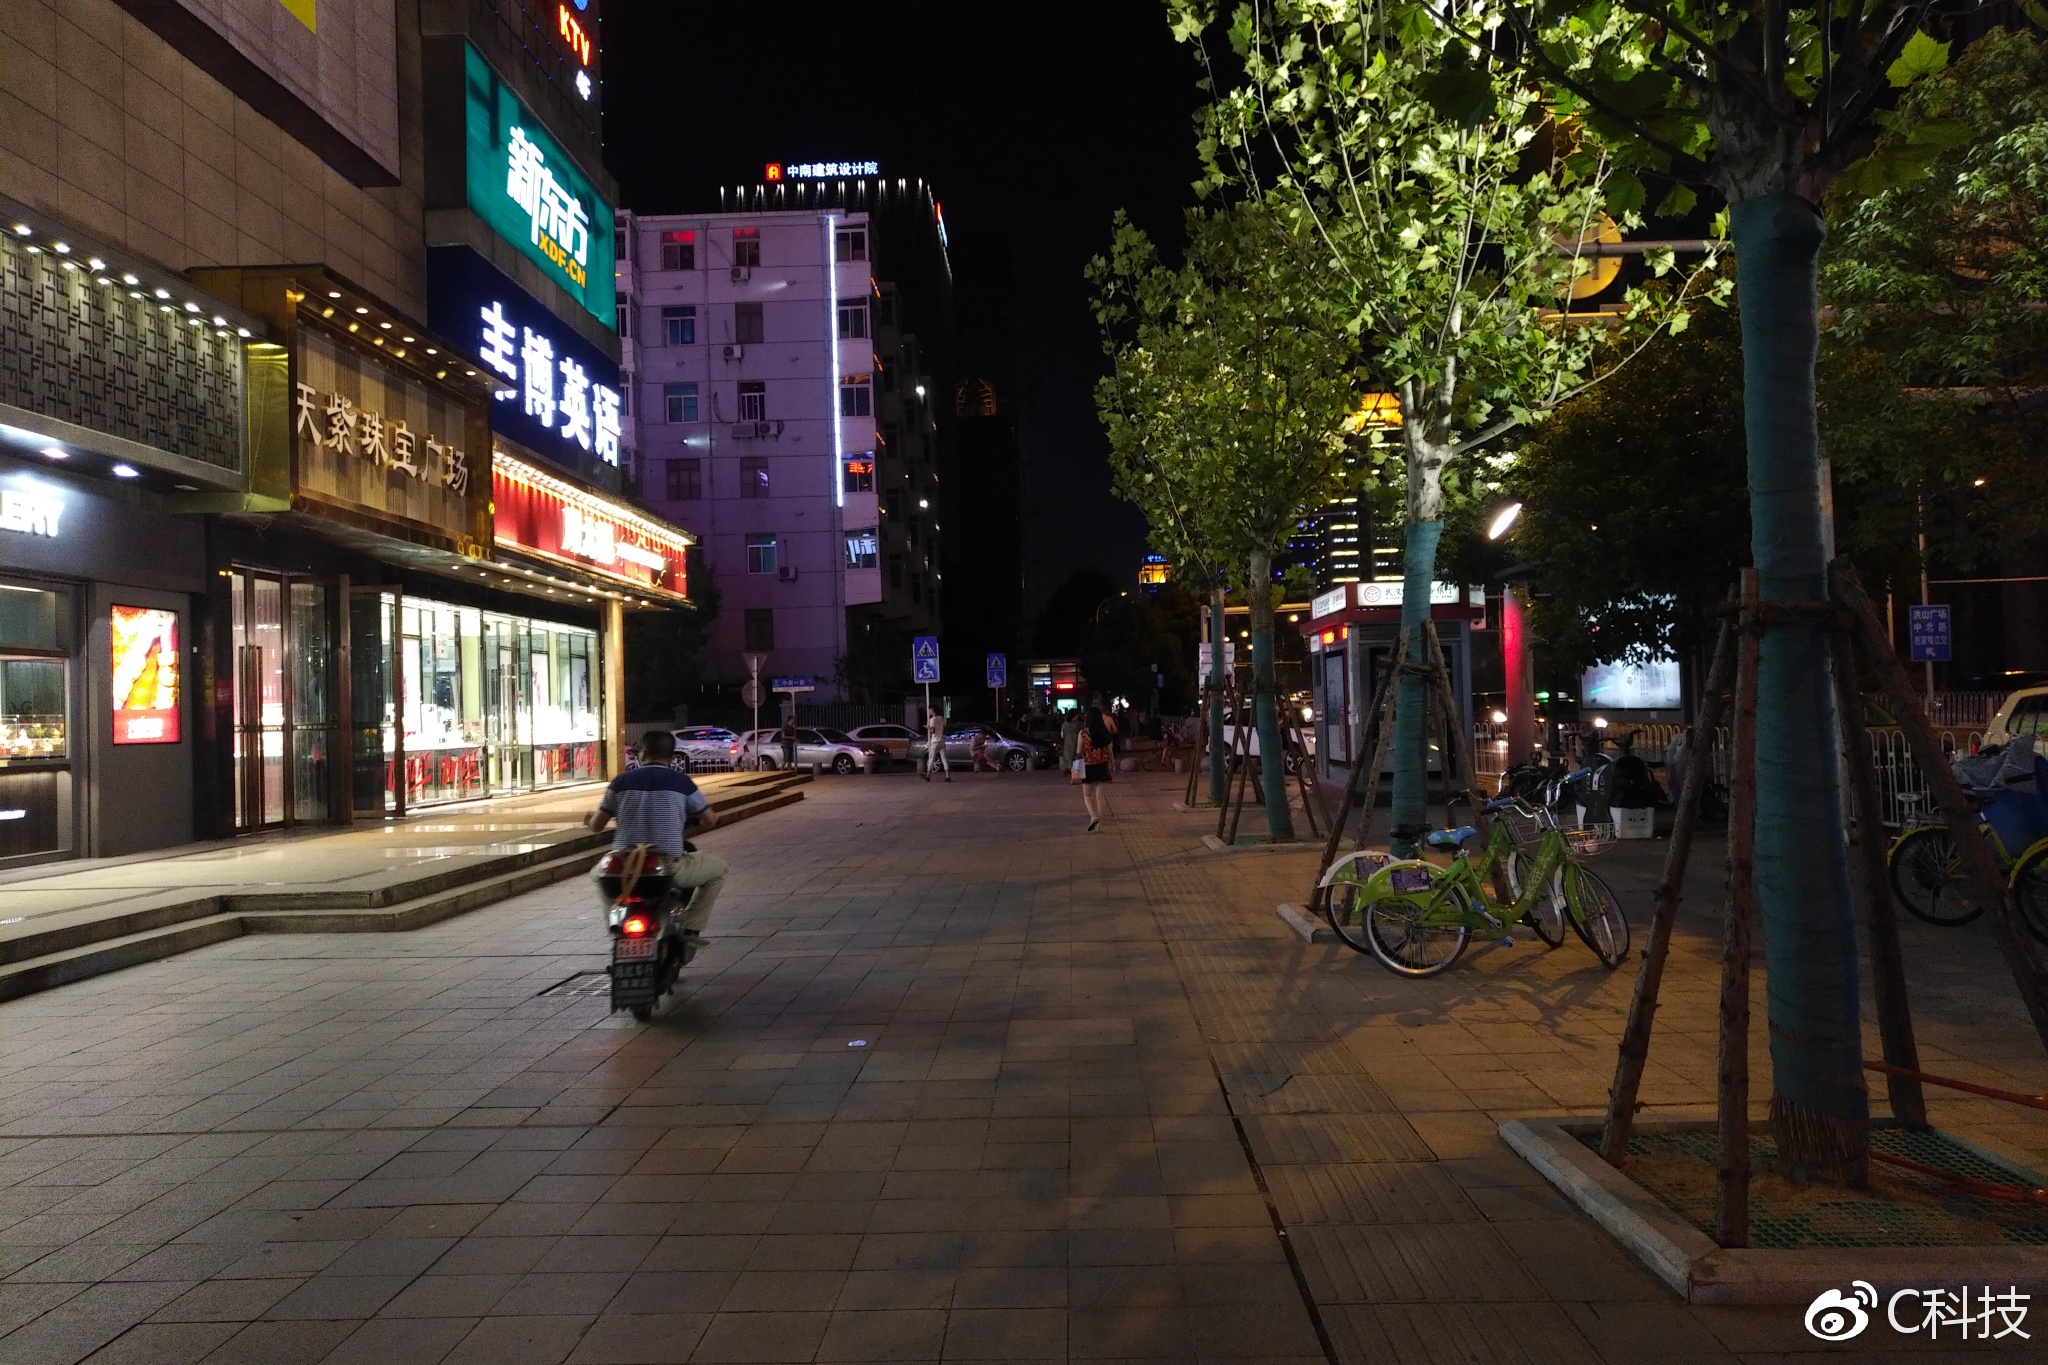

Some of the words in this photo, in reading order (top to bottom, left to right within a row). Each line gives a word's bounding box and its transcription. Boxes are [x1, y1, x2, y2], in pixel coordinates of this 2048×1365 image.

[559, 4, 590, 66] KTV
[506, 125, 589, 267] 新东方
[786, 161, 878, 178] 中南建筑设计院
[538, 230, 587, 289] XDF.CN
[297, 381, 469, 498] 天紫珠宝广场
